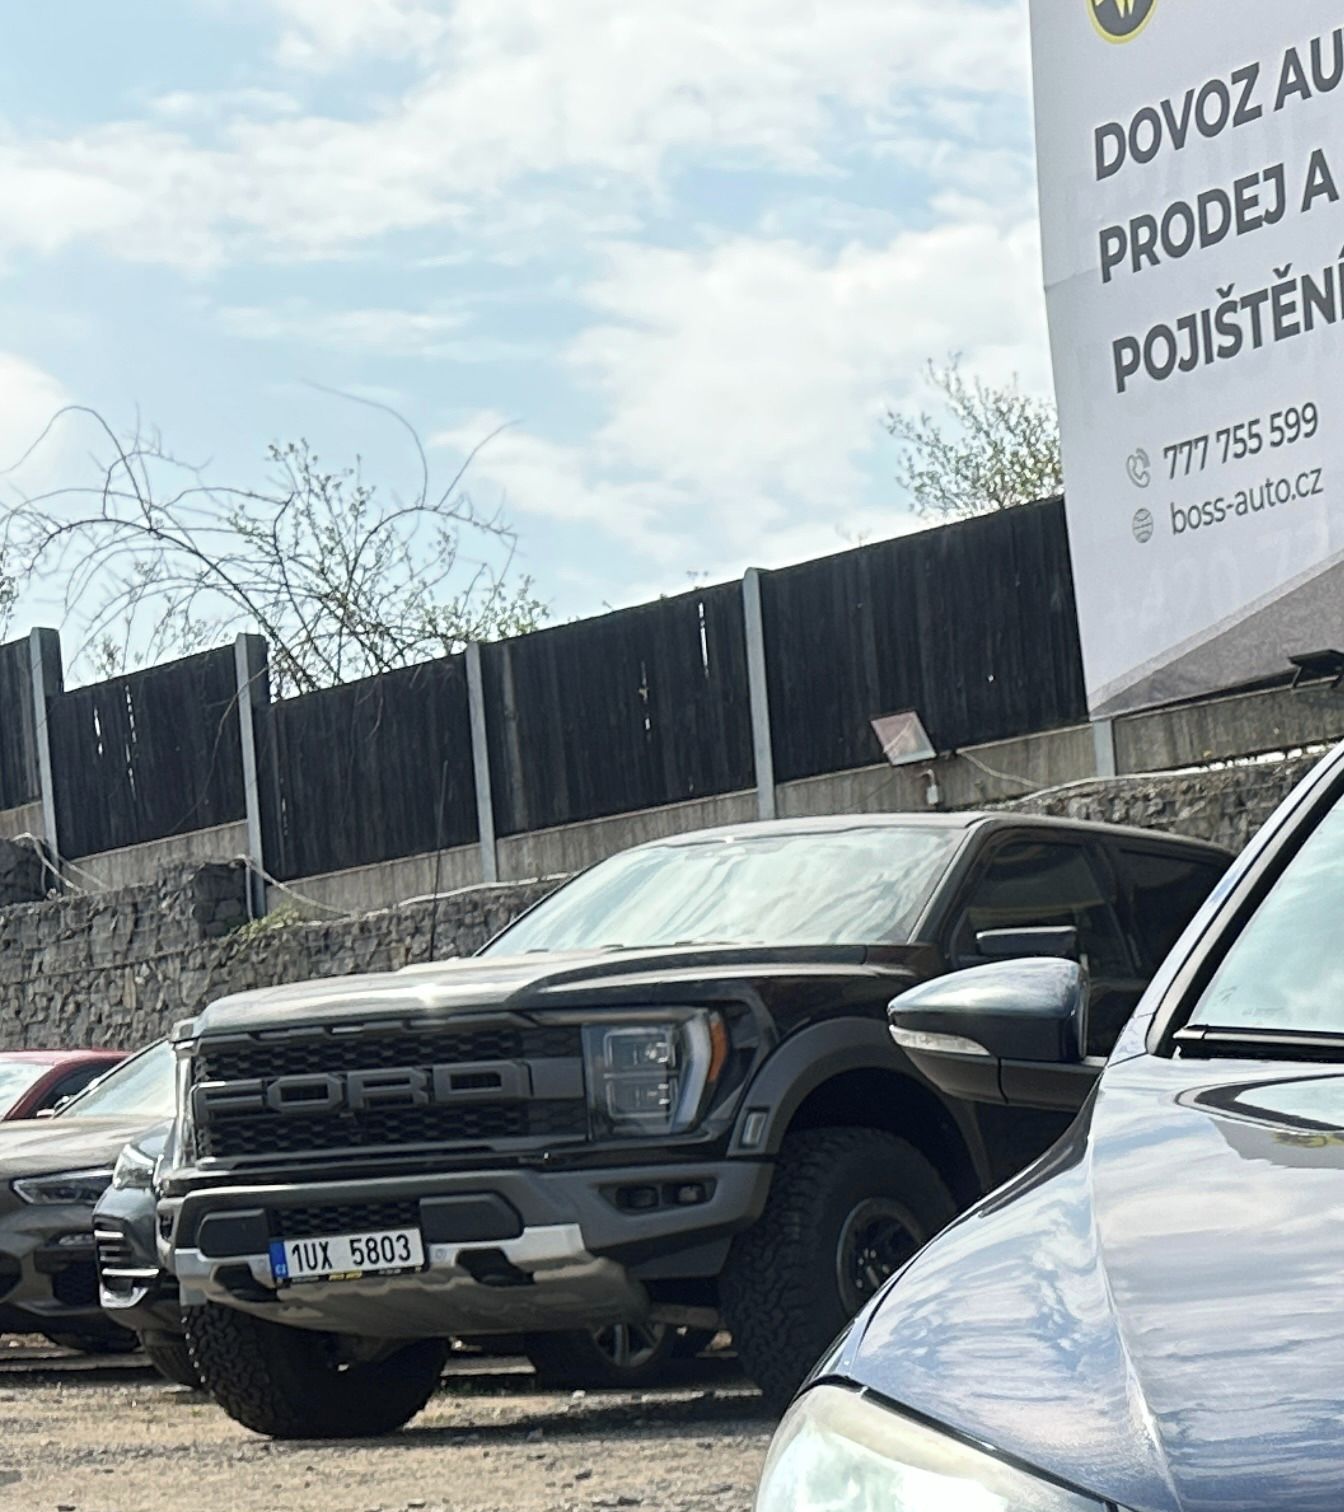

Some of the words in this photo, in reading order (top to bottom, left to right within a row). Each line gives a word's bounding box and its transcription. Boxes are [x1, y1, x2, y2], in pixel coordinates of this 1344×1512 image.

[1095, 62, 1262, 181] DOVOZ
[1099, 163, 1286, 284] PRODEJ
[1301, 148, 1339, 212] A
[1163, 434, 1209, 480] 777
[1216, 418, 1263, 464] 755
[1269, 402, 1318, 448] 599
[1170, 468, 1324, 535] boss-auto.cz
[190, 1060, 532, 1121] FORD
[292, 1241, 333, 1272] 1UX
[350, 1234, 411, 1266] 5803
